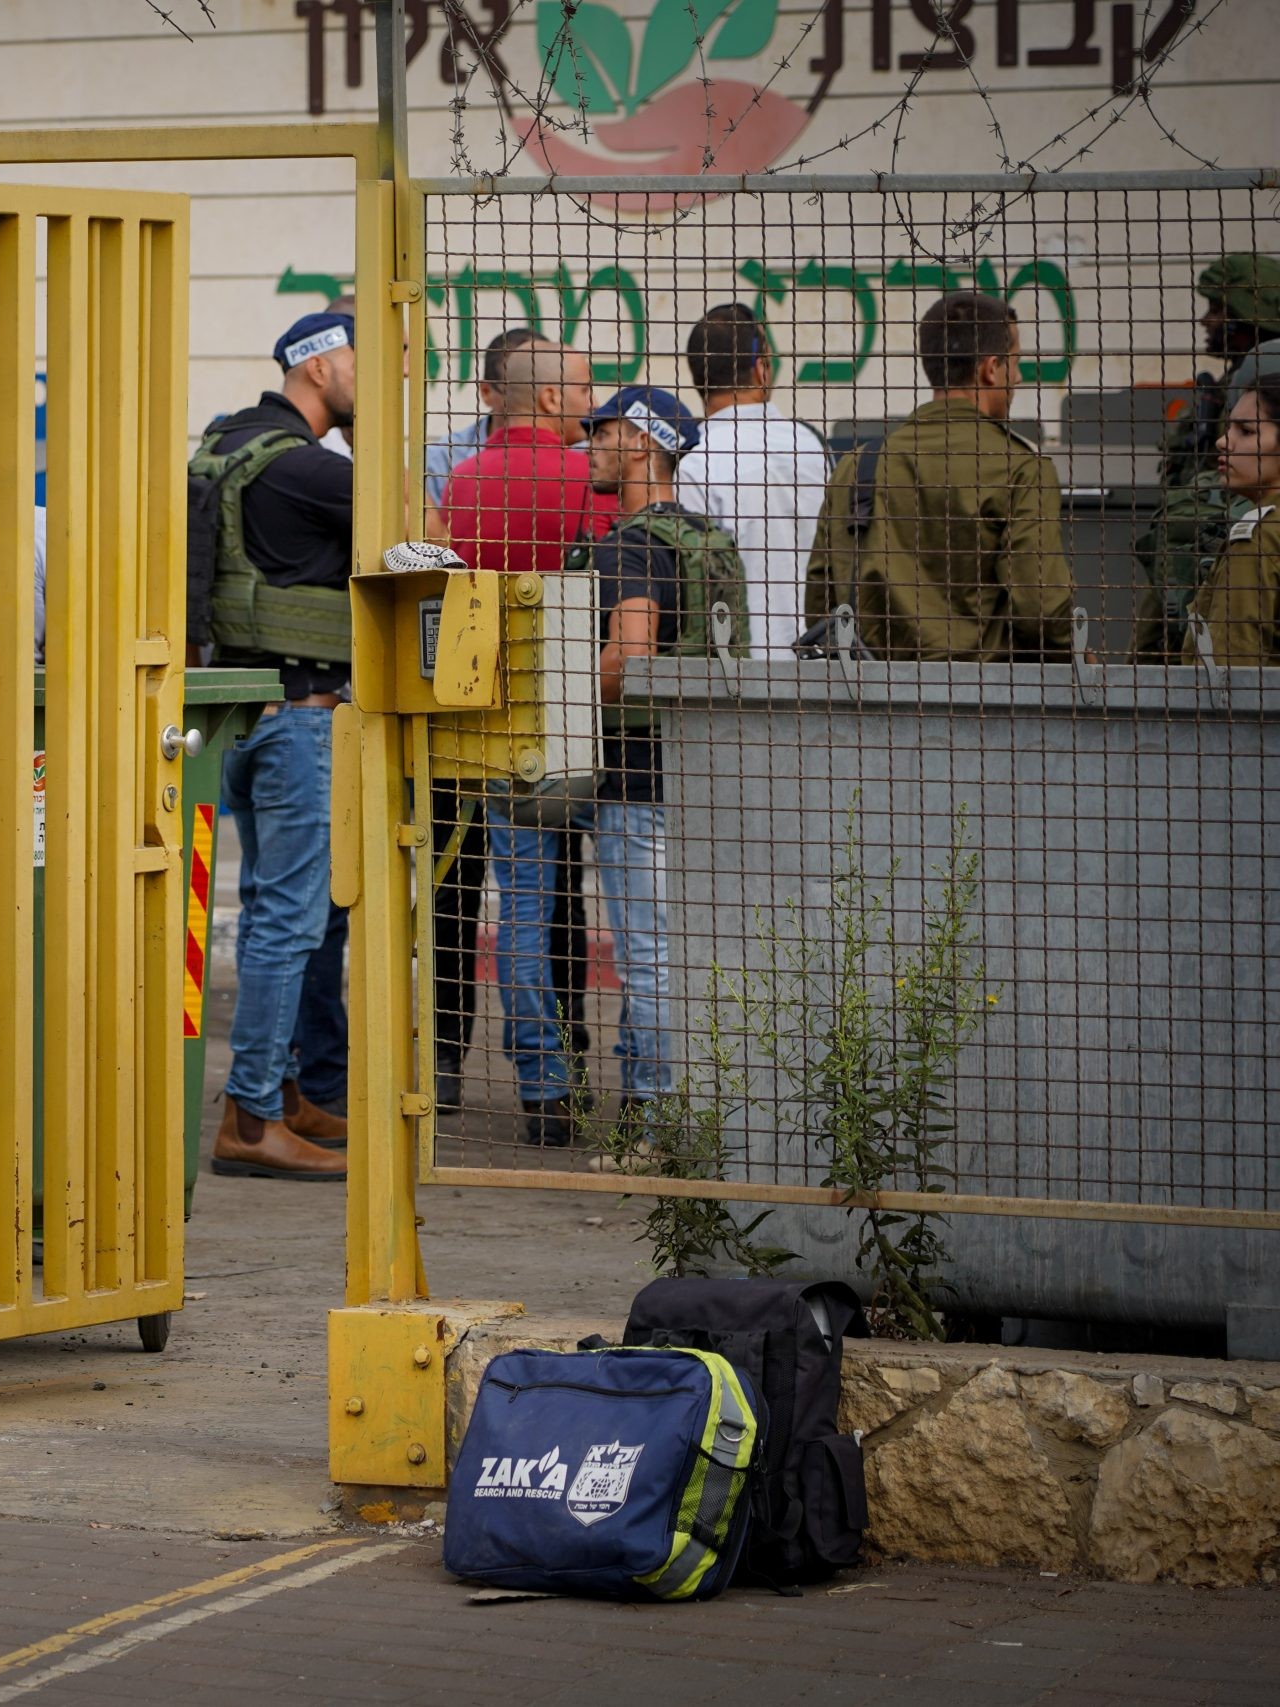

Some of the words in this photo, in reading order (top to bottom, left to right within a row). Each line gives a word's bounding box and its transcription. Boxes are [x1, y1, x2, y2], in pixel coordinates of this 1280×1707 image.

[277, 262, 645, 392] מחז
[474, 1487, 505, 1498] SEARCH
[506, 1488, 523, 1498] AND
[524, 1489, 563, 1500] RESCUE
